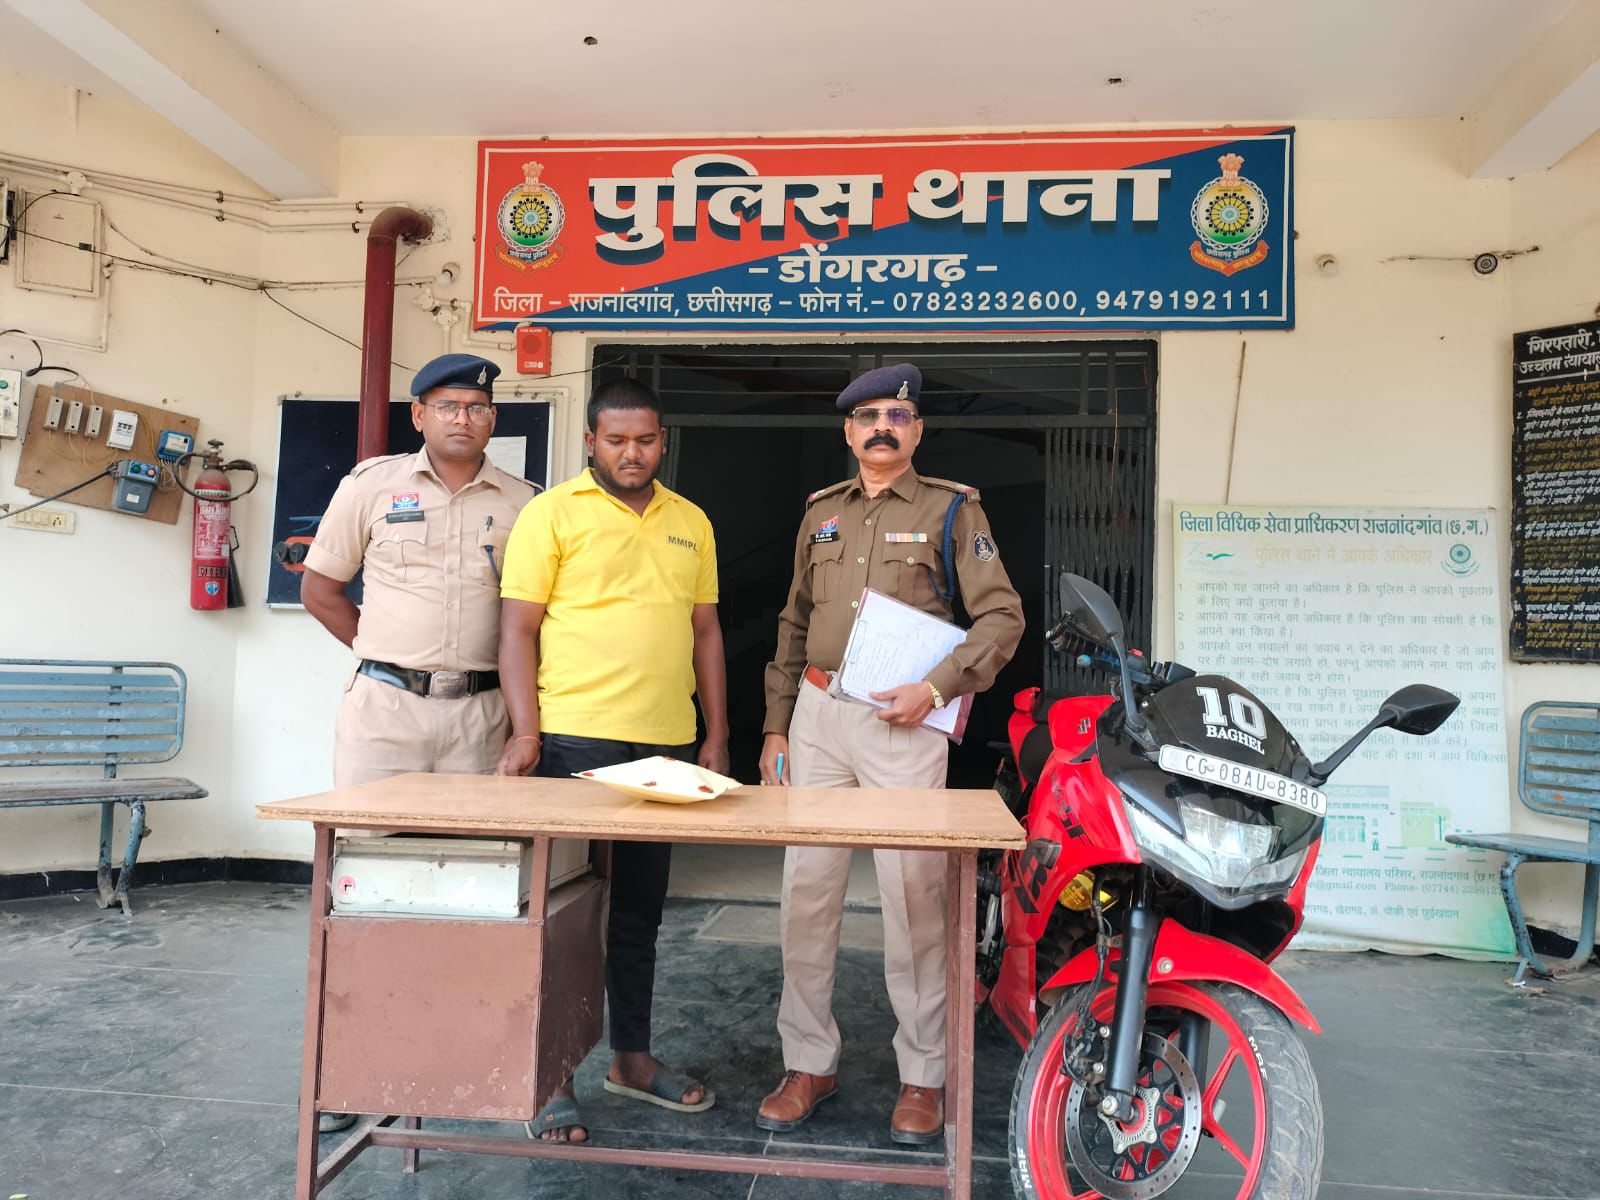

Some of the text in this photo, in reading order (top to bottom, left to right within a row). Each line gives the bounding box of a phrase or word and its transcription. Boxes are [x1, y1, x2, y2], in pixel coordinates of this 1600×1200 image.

[589, 153, 1171, 256] पुलिस थाना
[778, 243, 967, 288] डोंगरगढ़
[494, 286, 543, 313] जिला
[569, 286, 680, 317] राजनांदगांव,
[688, 286, 772, 316] छत्तीसगढ़
[800, 286, 842, 313] फोन
[893, 289, 1086, 315] 07823232600,
[1096, 289, 1270, 311] 9479192111
[1180, 511, 1212, 532] जिला
[1216, 511, 1260, 532] विधिक
[1265, 512, 1291, 533] सेवा
[1295, 512, 1360, 534] प्राधिकरण
[1363, 514, 1443, 536] राजनांदगांव
[668, 535, 698, 552] MMIPL
[1196, 687, 1267, 739] 10
[1206, 725, 1265, 755] BAGHEL
[1248, 1036, 1268, 1080] MRF
